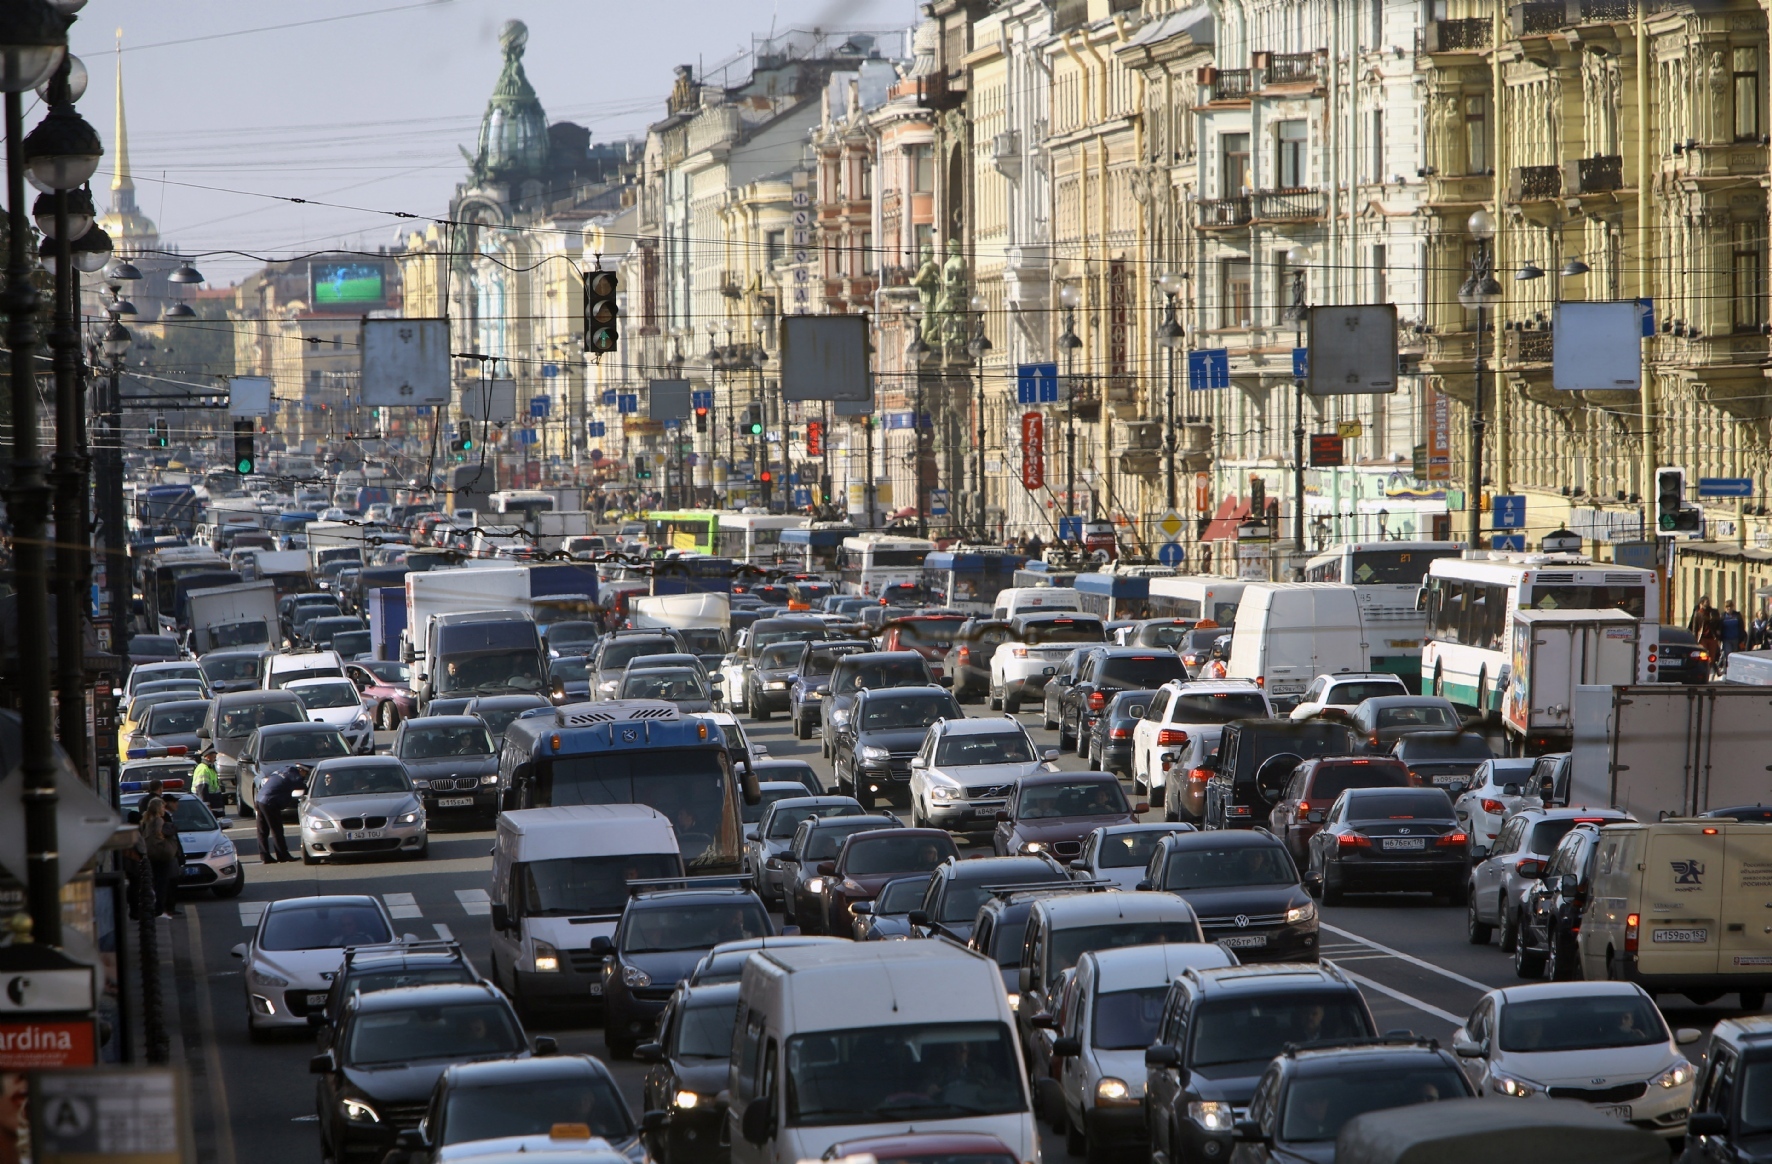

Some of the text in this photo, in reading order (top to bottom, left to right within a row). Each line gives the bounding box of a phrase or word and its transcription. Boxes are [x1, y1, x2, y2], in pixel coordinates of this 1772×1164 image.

[1400, 554, 1411, 562] 27
[1385, 839, 1412, 847] Н676ЕК
[1656, 930, 1705, 940] Н159ВО 152
